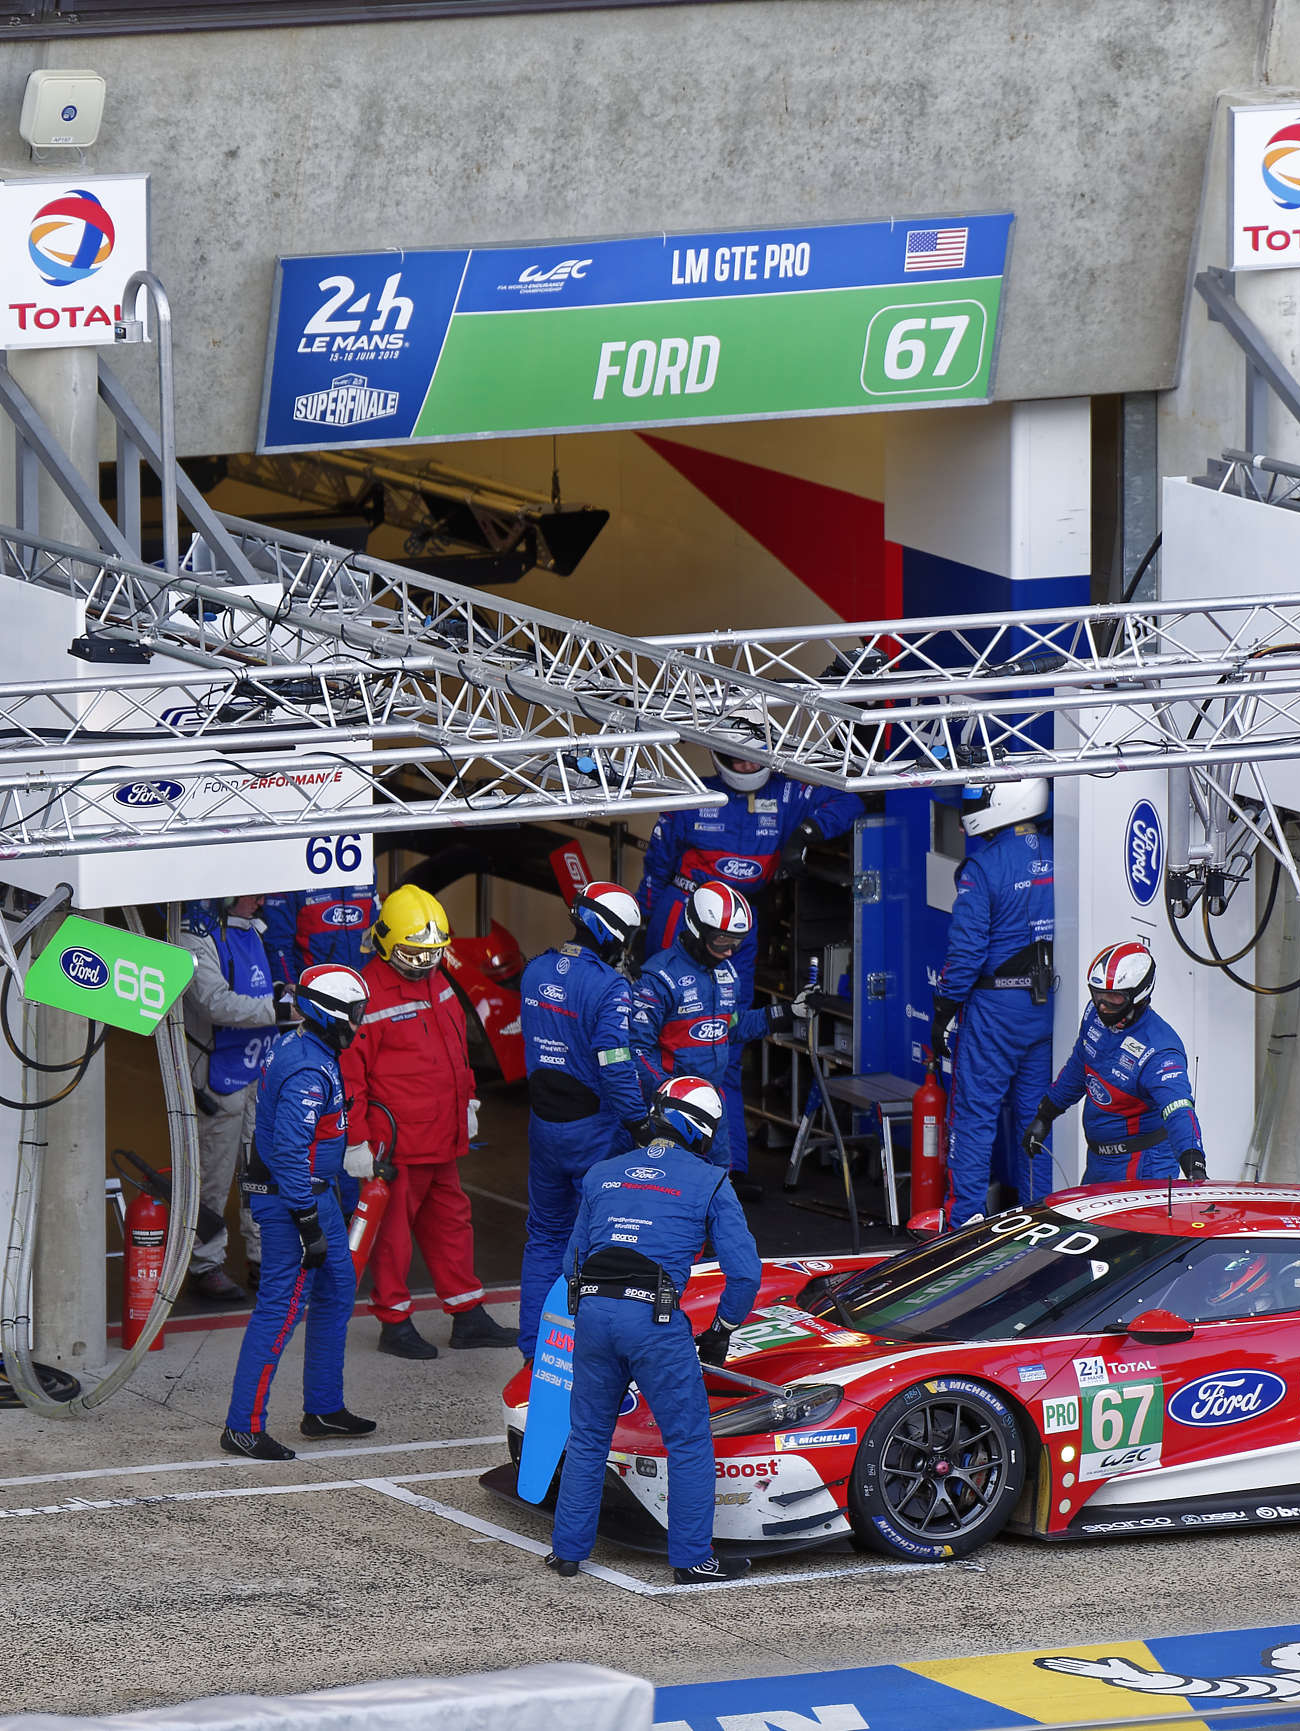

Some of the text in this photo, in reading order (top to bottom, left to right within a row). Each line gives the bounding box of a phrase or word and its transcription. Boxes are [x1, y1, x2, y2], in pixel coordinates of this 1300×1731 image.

[671, 242, 810, 285] LM GTE PRO
[304, 272, 413, 334] 24h
[297, 333, 404, 353] LE MANS
[883, 315, 970, 380] 67
[593, 336, 720, 400] FORD
[296, 388, 396, 424] SUPERFINALE
[204, 780, 239, 794] FORD
[306, 833, 362, 875] 66
[1132, 819, 1159, 887] Ford
[724, 860, 755, 877] Ford
[69, 951, 100, 984] Ford
[114, 958, 165, 1009] 66
[994, 976, 1032, 987] sparco
[543, 986, 565, 1000] Ford
[699, 1022, 724, 1039] Ford
[540, 1055, 566, 1065] sparco
[632, 1168, 659, 1179] Ford
[242, 1182, 268, 1193] sparco
[602, 1181, 621, 1189] FORD
[1077, 1194, 1139, 1213] FORD
[611, 1233, 638, 1243] sparco
[580, 1285, 599, 1295] arco
[624, 1287, 655, 1302] sparc
[802, 1318, 828, 1334] TOTAL
[544, 1329, 575, 1352] ART
[541, 1352, 555, 1365] ON
[535, 1367, 564, 1387] RESET
[1079, 1360, 1157, 1377] 24h TOTAL
[948, 1380, 1002, 1413] MICHELIN
[1191, 1378, 1266, 1420] Ford
[1046, 1402, 1077, 1428] PRO
[1091, 1384, 1155, 1450] 67
[798, 1433, 850, 1446] MICHELIN
[1100, 1448, 1152, 1468] WEC
[715, 1459, 778, 1479] Boost
[714, 1491, 752, 1505] DGE
[1082, 1517, 1173, 1533] sparco
[877, 1519, 934, 1556] MICHELIN
